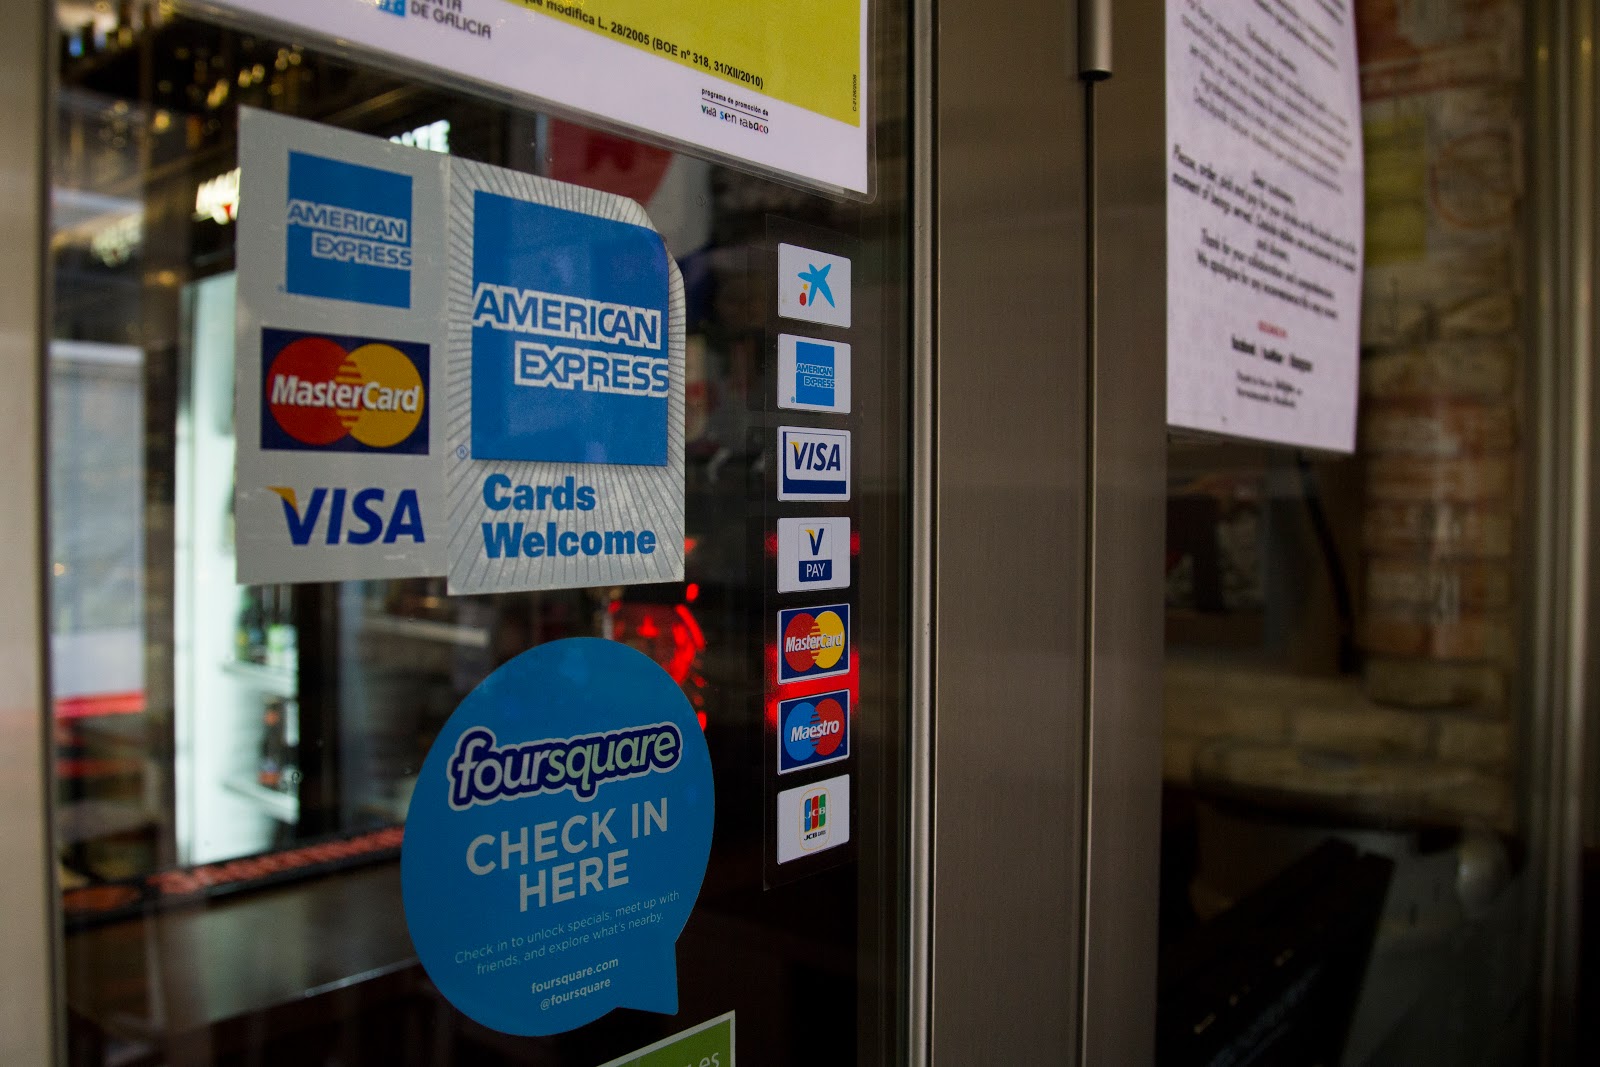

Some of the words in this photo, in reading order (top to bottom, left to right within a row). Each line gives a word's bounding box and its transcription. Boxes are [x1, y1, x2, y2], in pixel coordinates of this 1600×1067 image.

[411, 1, 429, 20] DE
[433, 8, 492, 40] GALICIA
[546, 0, 595, 25] modifica
[598, 16, 608, 30] L.
[611, 21, 650, 46] 28/2005
[652, 37, 678, 57] (BOE
[693, 53, 712, 71] 318,
[714, 60, 764, 90] 31/XII/2010)
[701, 88, 727, 102] programa
[727, 97, 734, 105] de
[735, 100, 761, 114] promoción
[720, 111, 737, 124] sen
[739, 118, 769, 134] tabaco
[288, 200, 408, 243] AMERICAN
[312, 232, 412, 267] EXPRESS
[473, 283, 661, 349] AMERICAN
[515, 340, 669, 398] EXPRESS
[796, 362, 833, 377] AMERICAN
[804, 375, 835, 389] EXPRESS
[271, 374, 420, 413] MasterCard
[790, 442, 841, 471] VISA
[482, 474, 596, 511] Cards
[267, 486, 425, 545] VISA
[482, 522, 656, 559] Welcome
[805, 528, 824, 556] V
[806, 563, 825, 578] PAY
[785, 631, 843, 653] MasterCard
[791, 718, 840, 743] Maestro
[450, 724, 682, 809] foursquare
[466, 803, 618, 876] CHECK
[631, 797, 669, 839] IN
[519, 849, 630, 913] HERE
[454, 943, 494, 965] Check
[497, 939, 508, 952] in
[511, 935, 524, 948] to
[527, 923, 565, 944] unlock
[567, 910, 613, 933] specials,
[615, 903, 641, 918] meet
[643, 897, 657, 912] up
[659, 890, 680, 905] with
[476, 955, 521, 976] friends,
[524, 946, 546, 962] and
[548, 932, 590, 955] explore
[628, 911, 664, 931] nearby.
[531, 957, 619, 994] foursquare.com
[540, 977, 611, 1012] @foursquare
